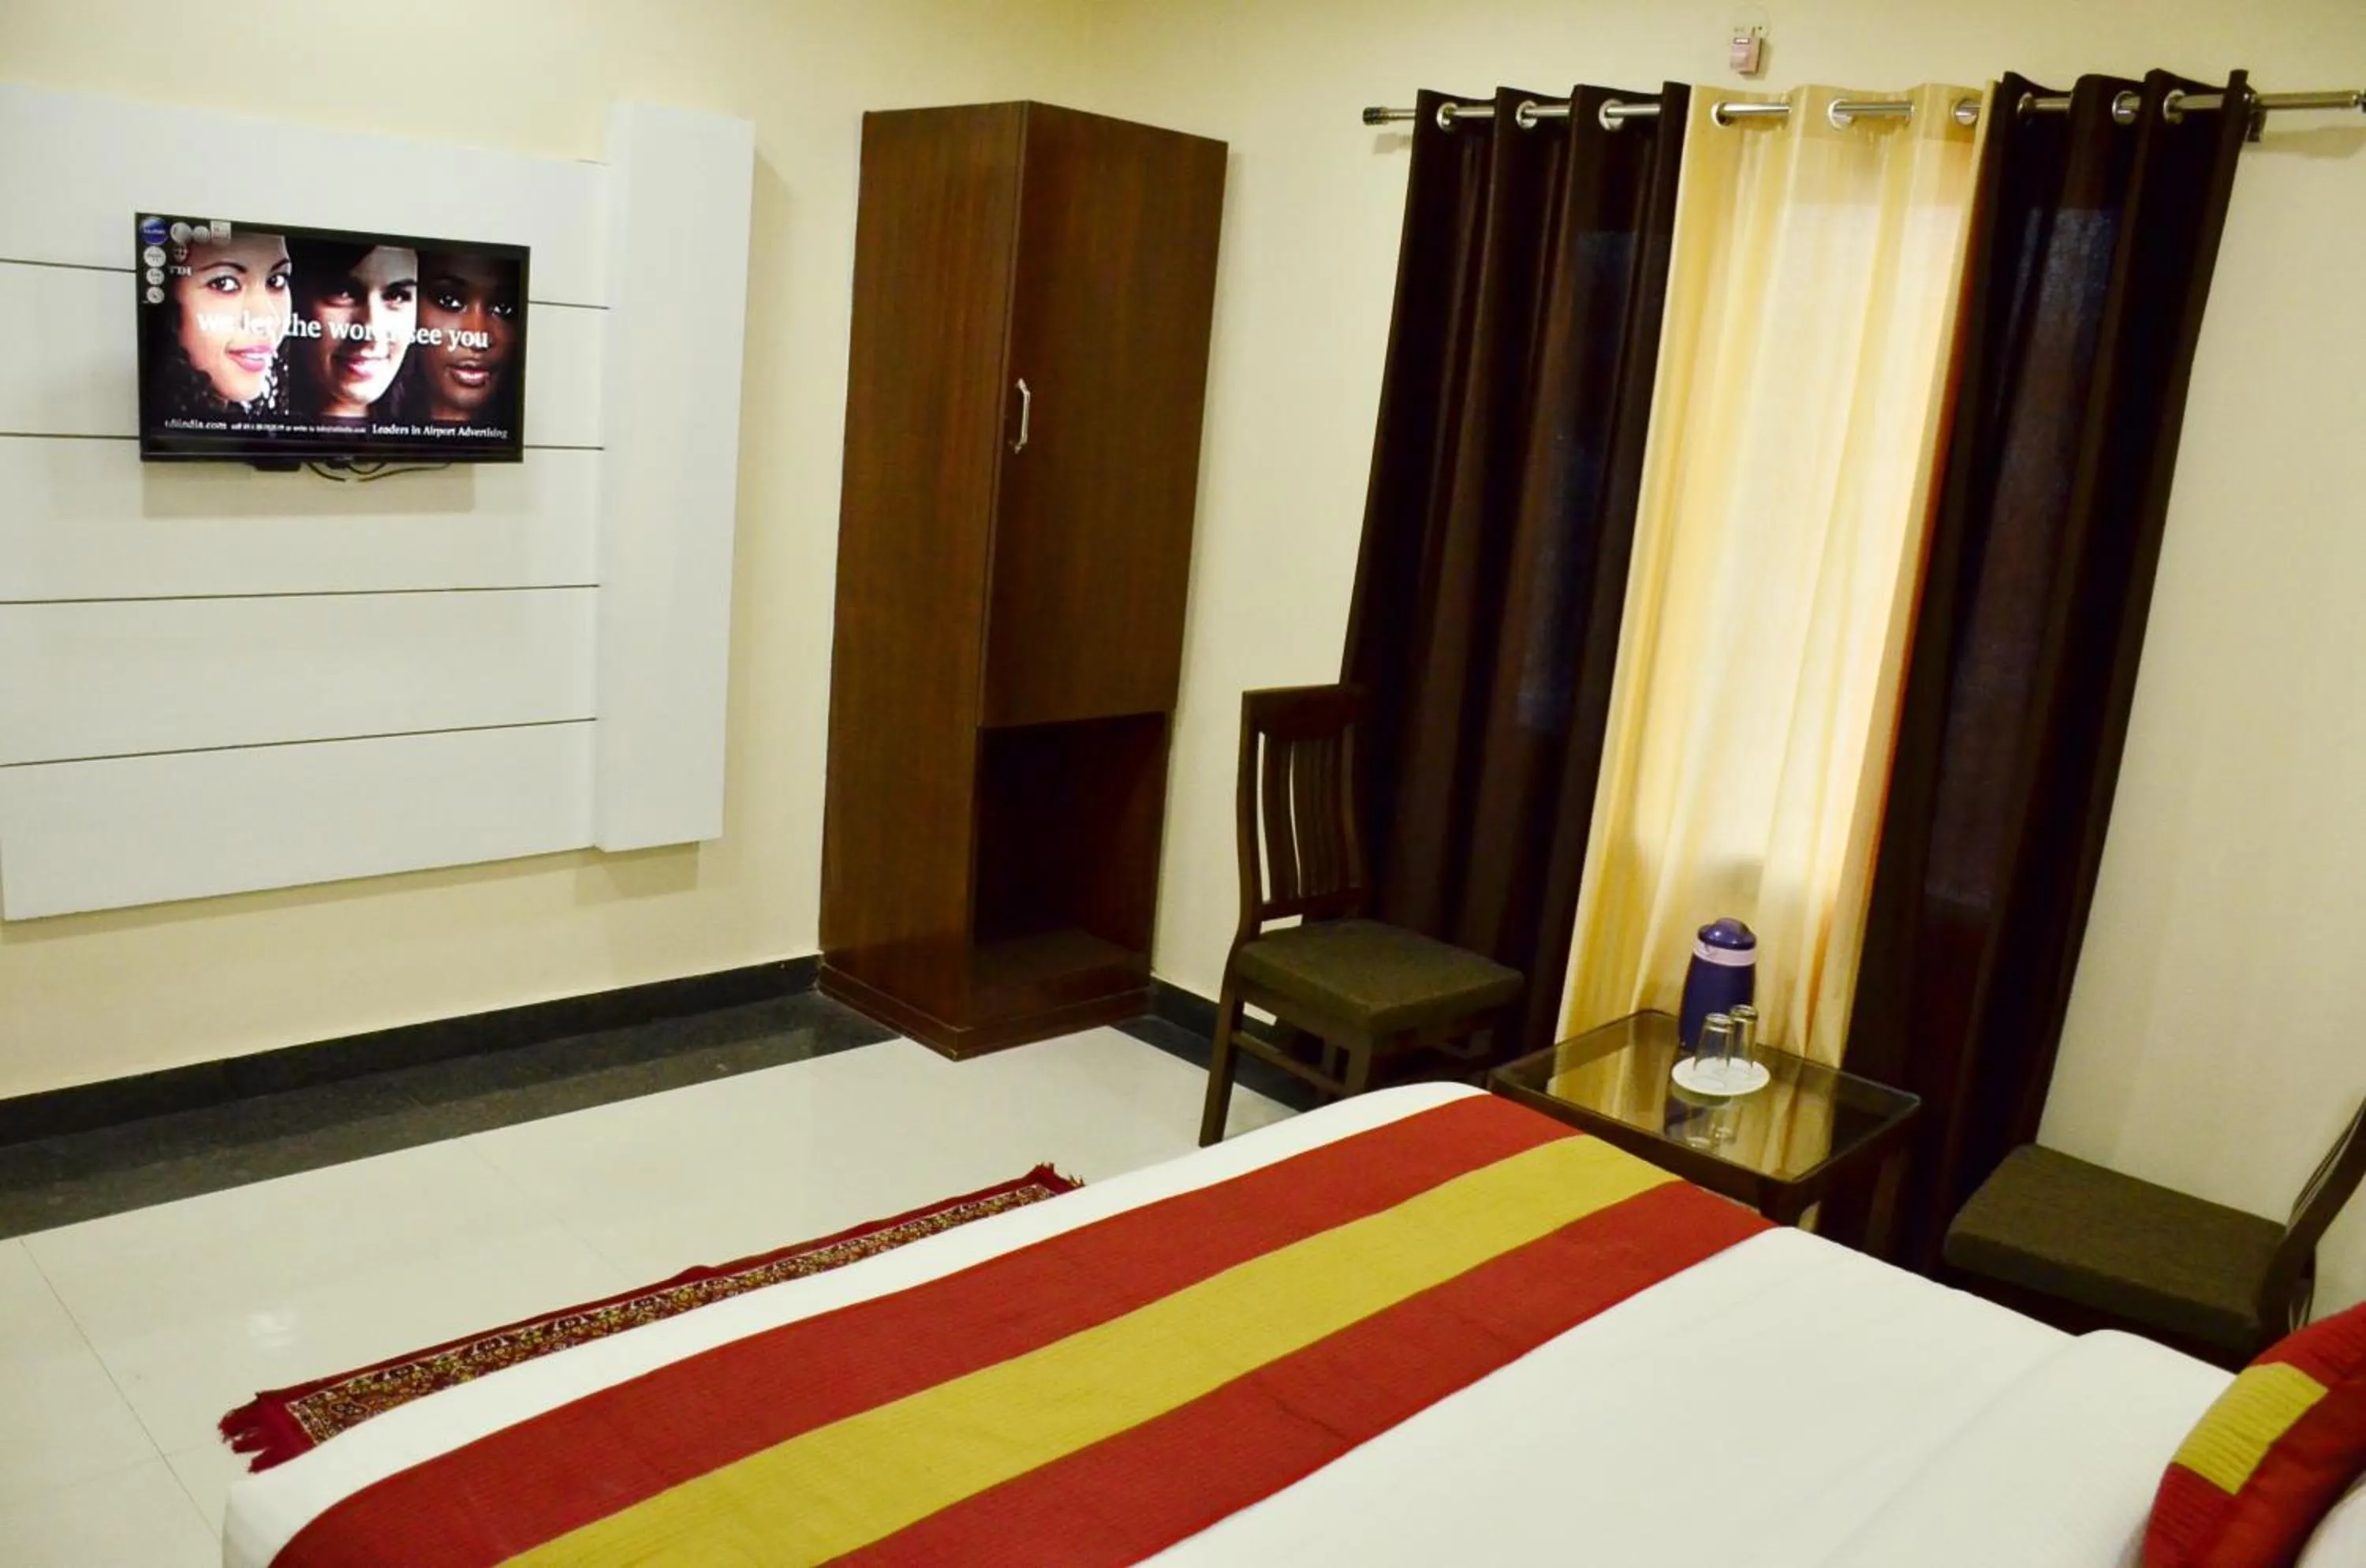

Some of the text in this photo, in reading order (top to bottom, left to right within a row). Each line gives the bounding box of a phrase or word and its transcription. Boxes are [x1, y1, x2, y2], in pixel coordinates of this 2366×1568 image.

[447, 327, 490, 353] you
[372, 424, 409, 435] Leaders
[424, 426, 456, 437] Airport
